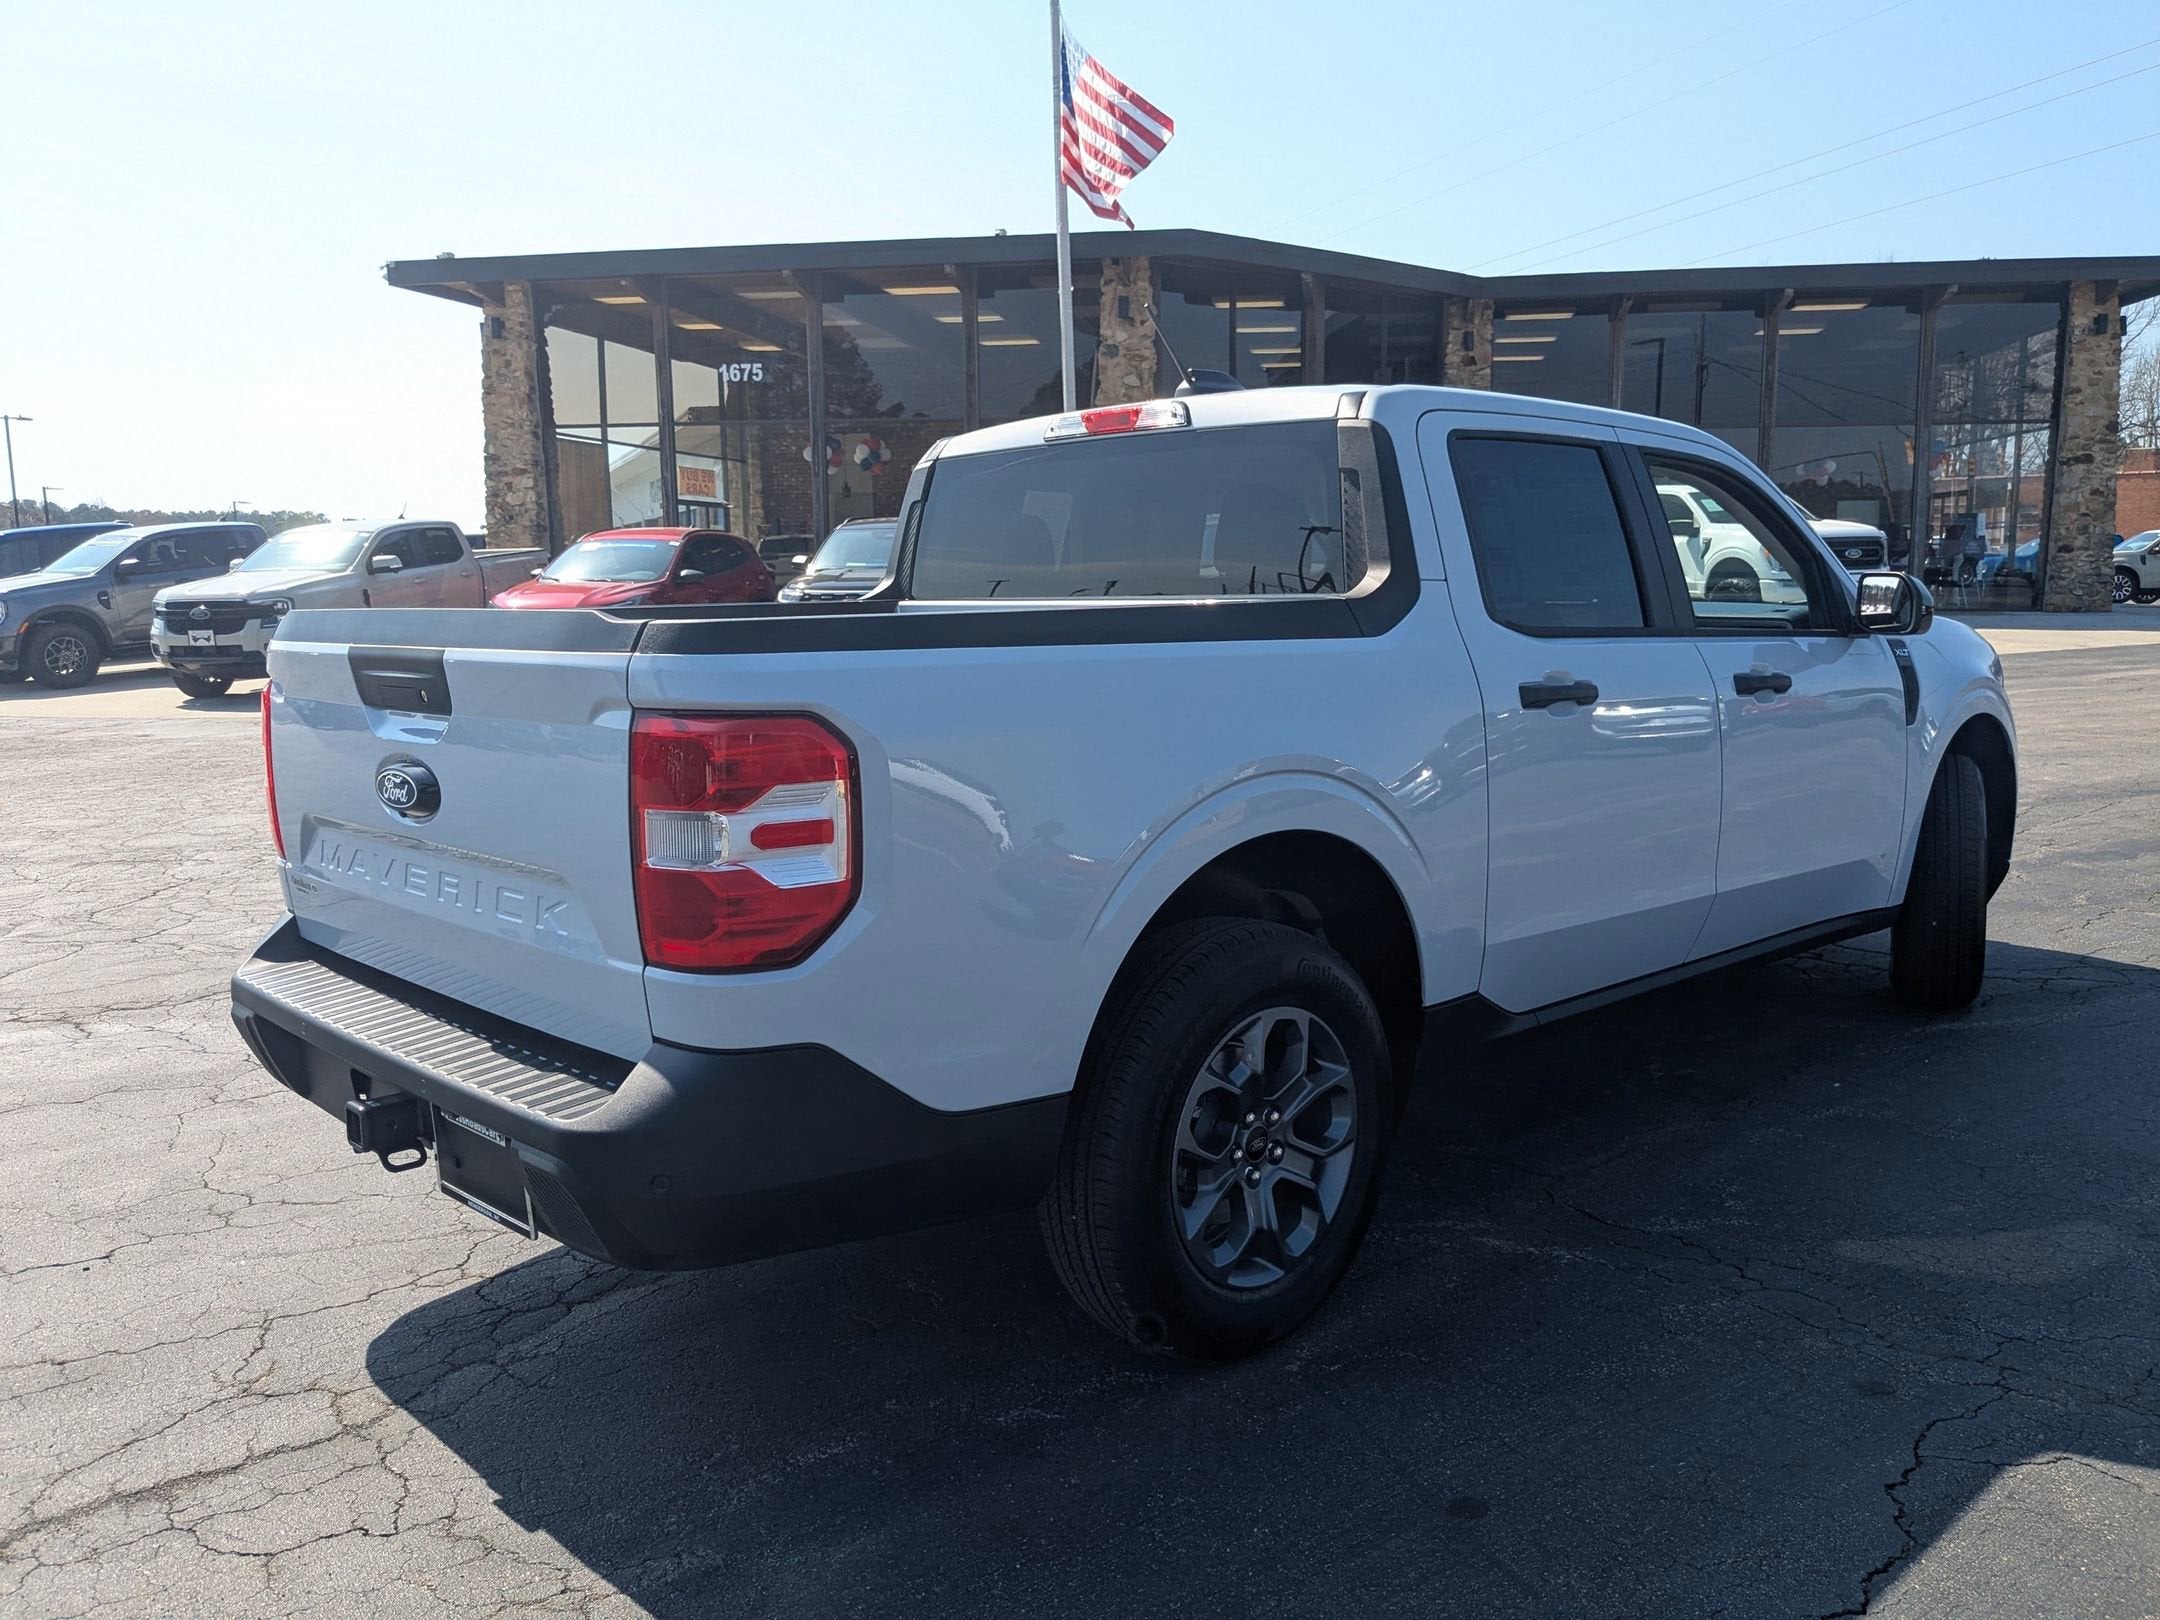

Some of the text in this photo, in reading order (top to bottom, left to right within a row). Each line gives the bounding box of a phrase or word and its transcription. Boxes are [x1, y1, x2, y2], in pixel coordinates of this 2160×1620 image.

[719, 363, 763, 382] 1675
[382, 774, 410, 803] Ford
[319, 839, 568, 936] MAVERICK
